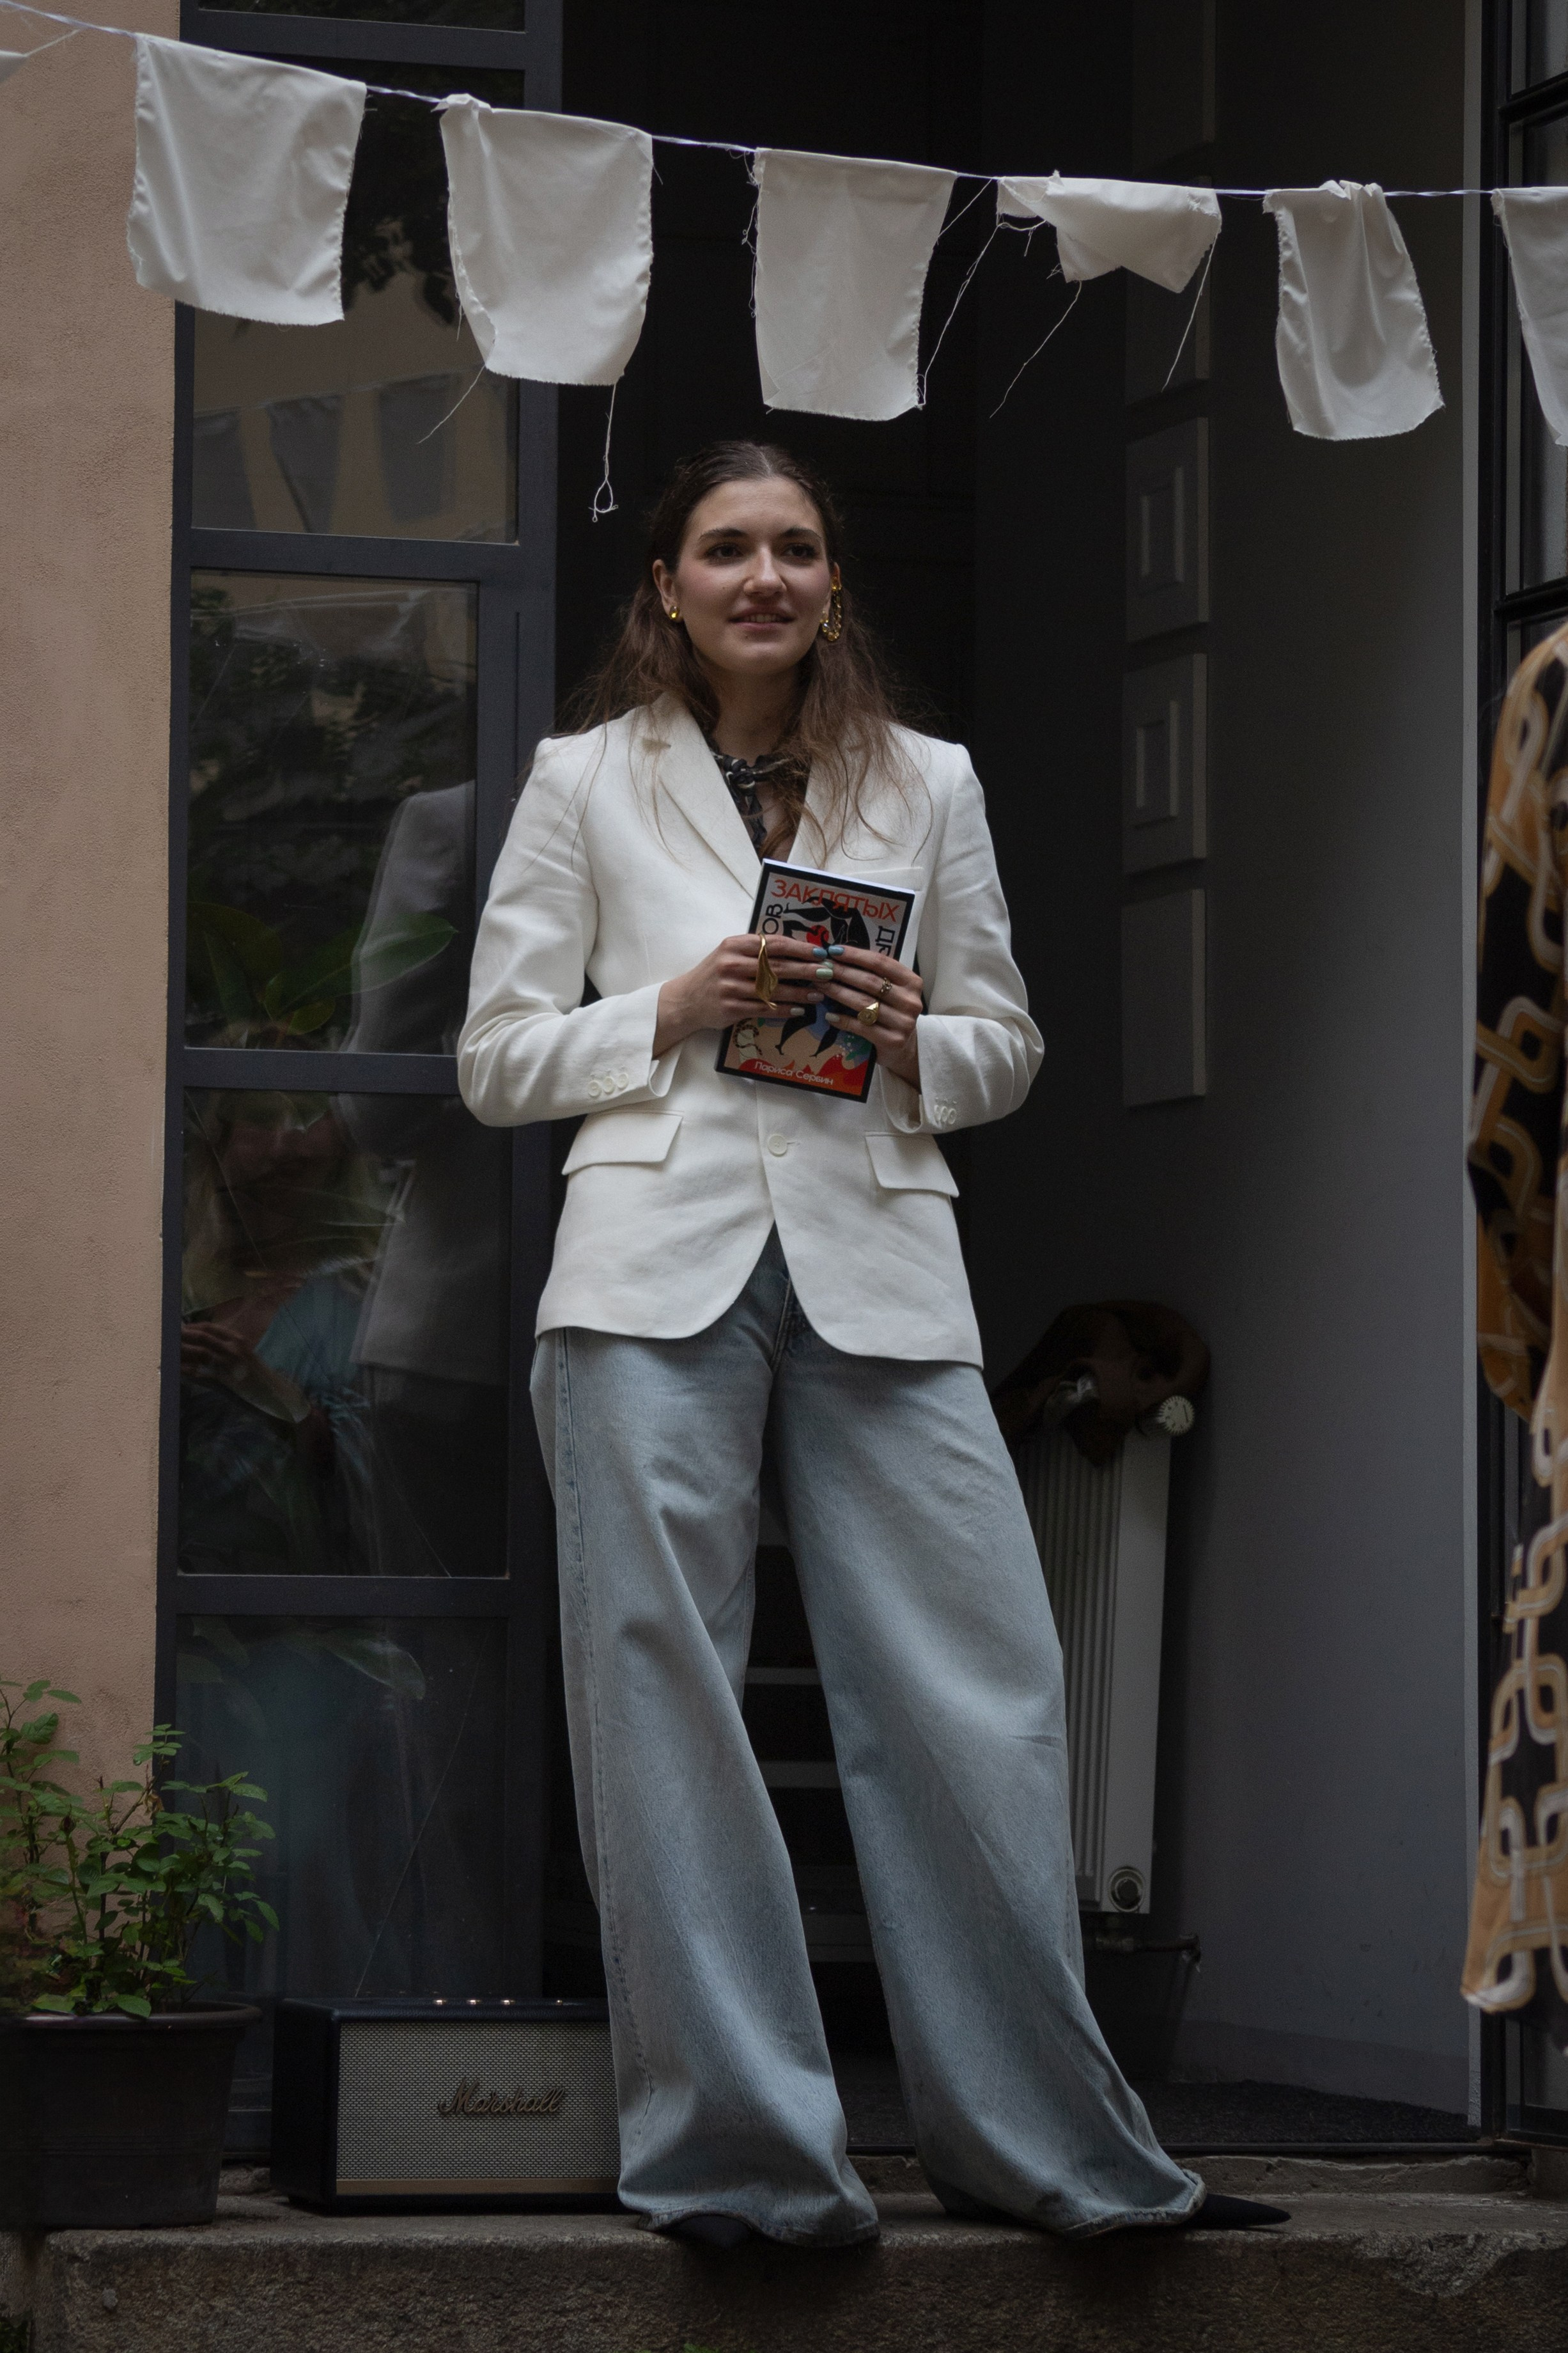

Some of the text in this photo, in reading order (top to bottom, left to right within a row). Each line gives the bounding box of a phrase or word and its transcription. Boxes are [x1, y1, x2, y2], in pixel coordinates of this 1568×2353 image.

[770, 879, 900, 923] ЗАКЛЯТЫХ
[754, 1061, 834, 1085] Лариса Сербин
[439, 2077, 566, 2113] Marshall
